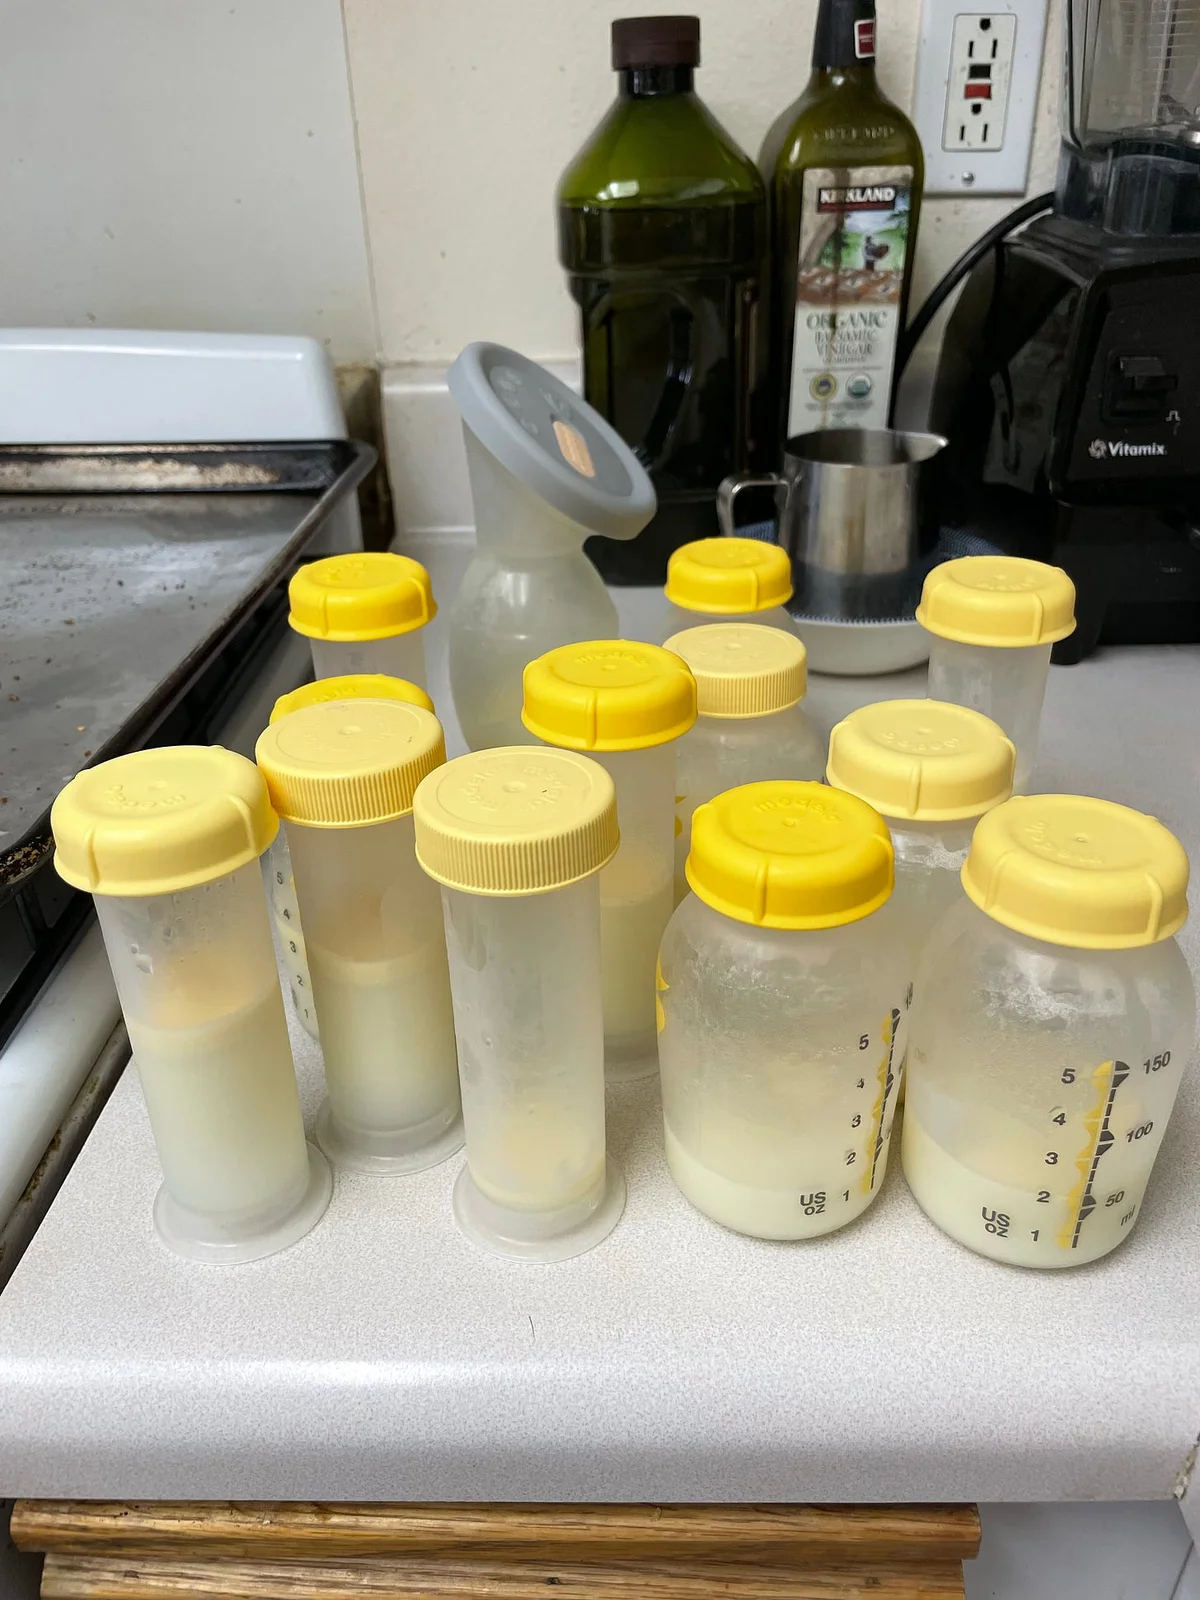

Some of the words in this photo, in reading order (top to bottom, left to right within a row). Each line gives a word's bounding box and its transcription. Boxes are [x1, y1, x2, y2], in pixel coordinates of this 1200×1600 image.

[1108, 441, 1166, 457] Vitamix
[859, 1034, 869, 1050] 5
[1143, 1051, 1171, 1075] 150
[856, 1078, 865, 1089] 4
[1061, 1068, 1076, 1084] 5
[851, 1115, 861, 1128] 3
[1052, 1112, 1067, 1126] 4
[1126, 1122, 1154, 1143] 100
[846, 1152, 856, 1165] 2
[1044, 1152, 1059, 1165] 3
[800, 1191, 826, 1206] US
[843, 1189, 850, 1201] 1
[1036, 1190, 1051, 1203] 2
[1105, 1190, 1125, 1207] 50
[981, 1206, 1011, 1228] US
[1120, 1205, 1136, 1227] ml
[1030, 1229, 1040, 1242] 1
